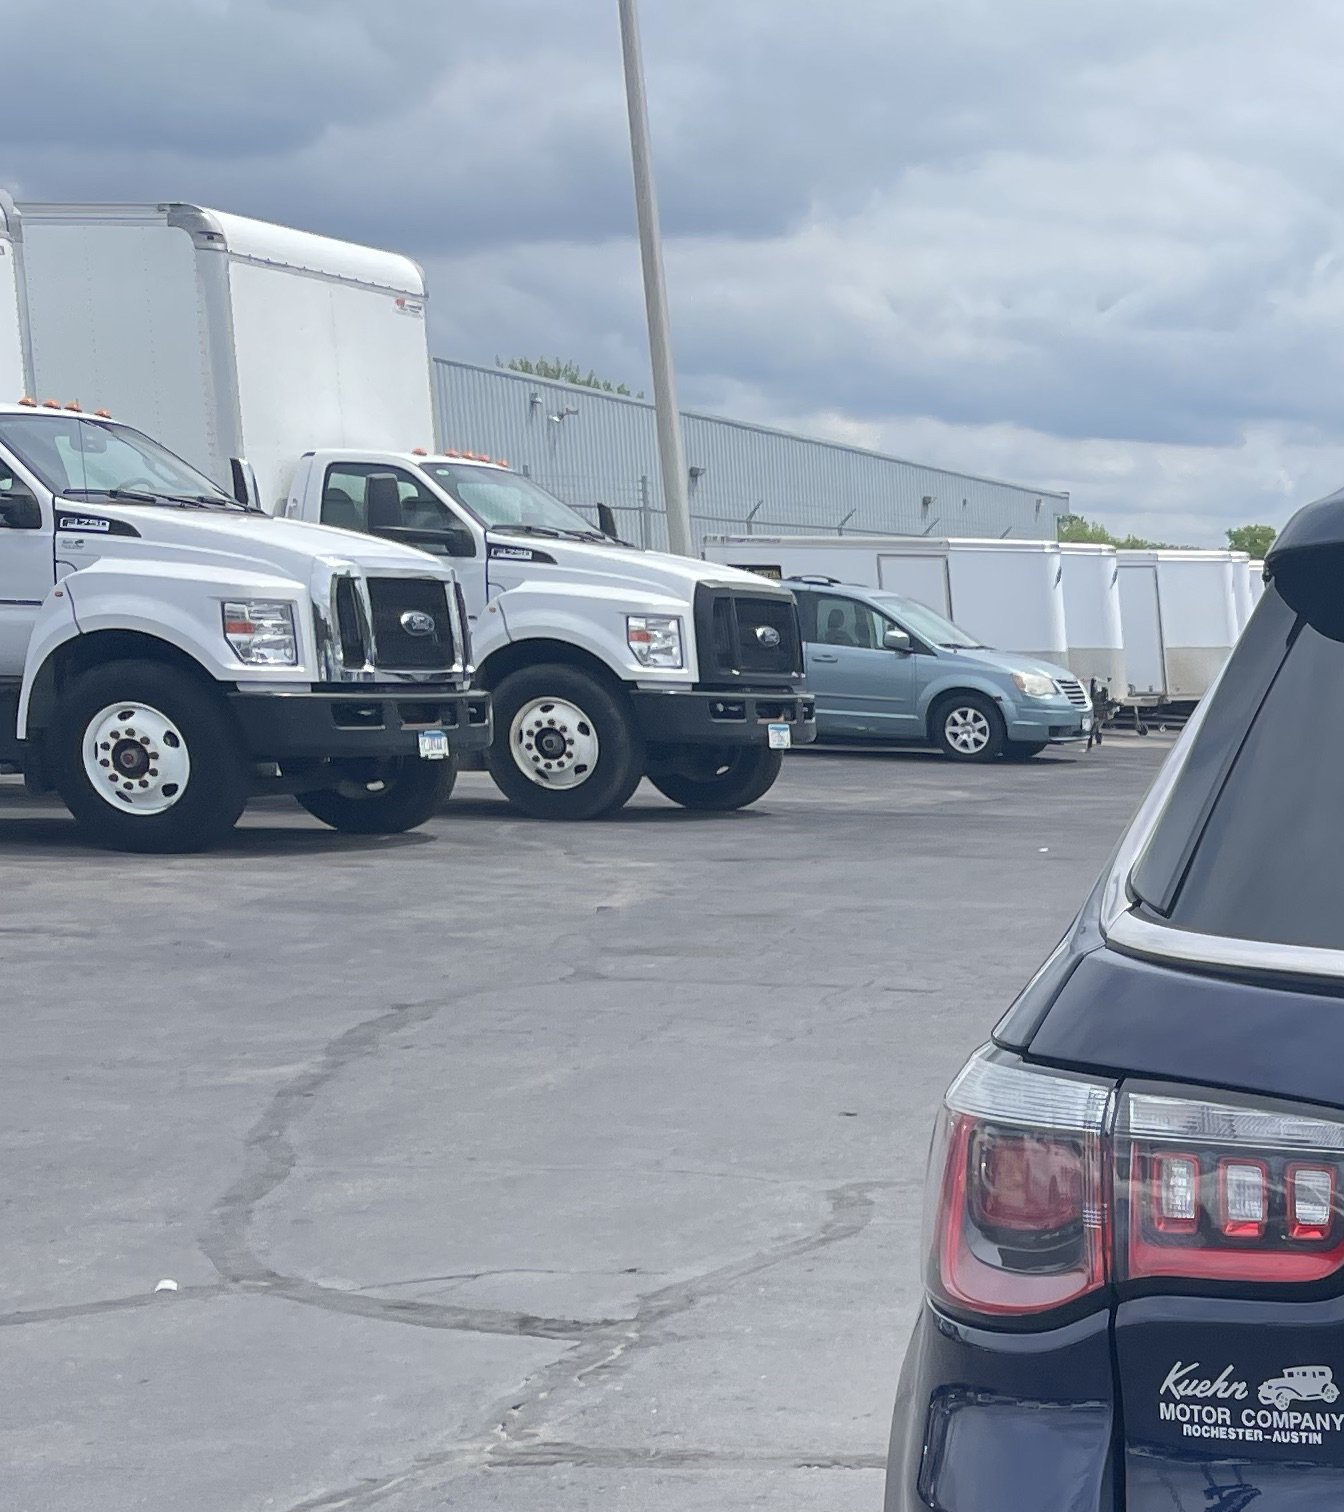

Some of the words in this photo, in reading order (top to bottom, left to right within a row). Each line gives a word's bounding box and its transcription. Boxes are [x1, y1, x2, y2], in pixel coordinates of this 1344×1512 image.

[1159, 1361, 1249, 1400] Kuehn
[1159, 1402, 1231, 1425] MOTOR
[1241, 1408, 1344, 1431] COMPANY
